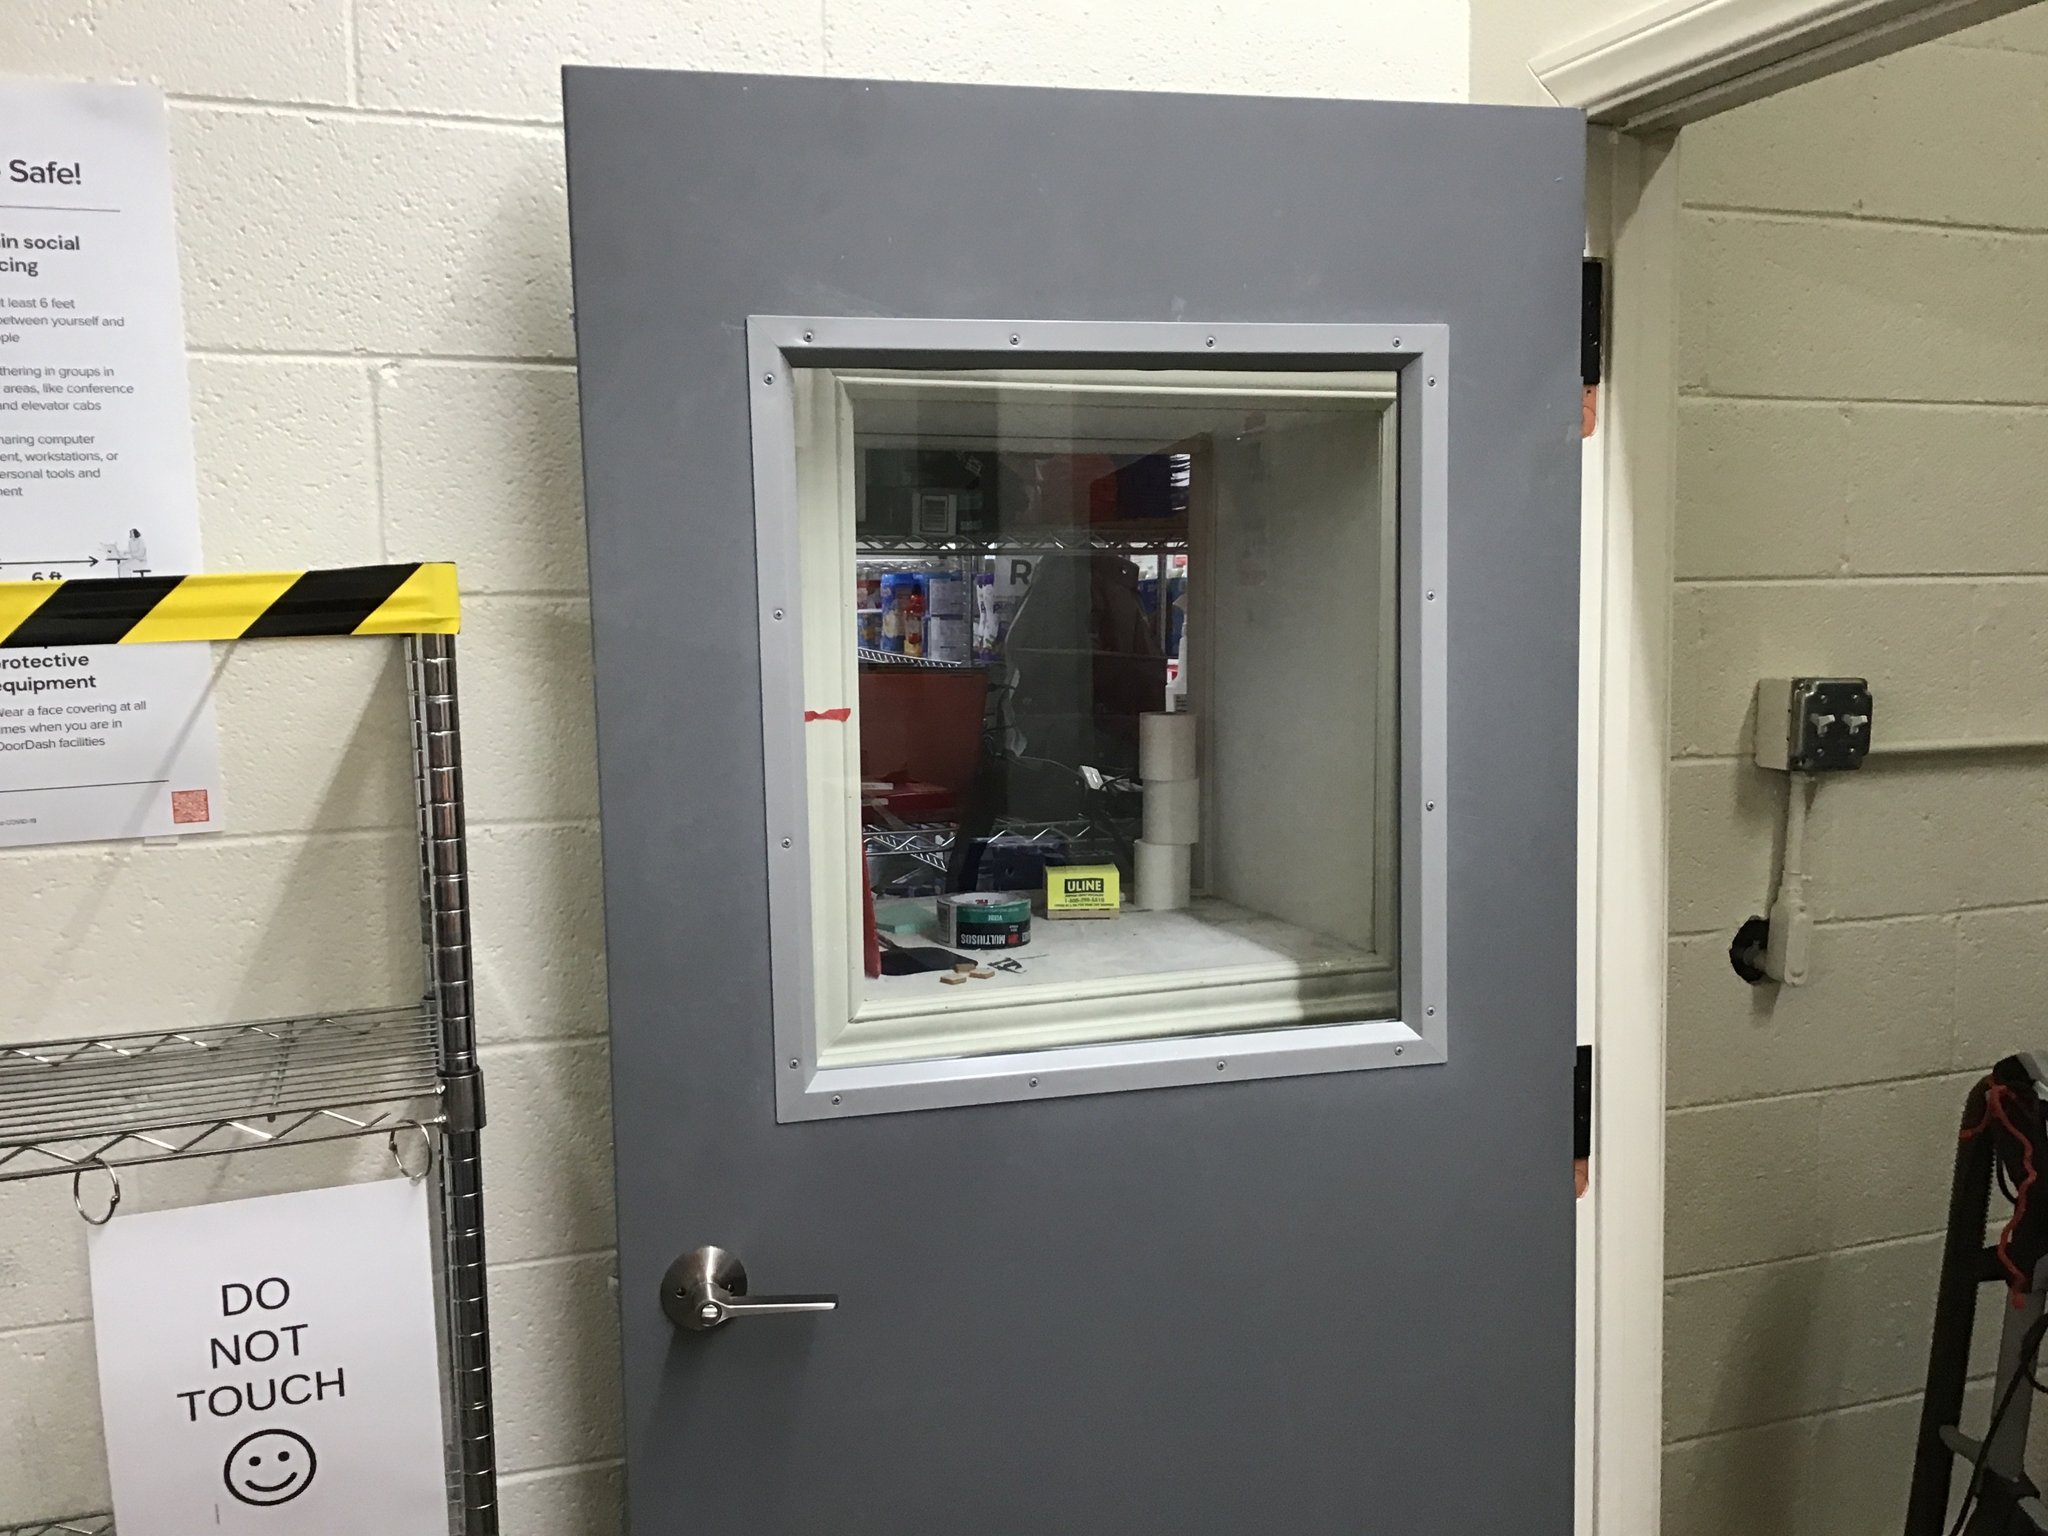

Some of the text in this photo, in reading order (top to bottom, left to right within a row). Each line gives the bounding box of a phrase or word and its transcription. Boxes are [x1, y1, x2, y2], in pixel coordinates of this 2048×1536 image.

[9, 159, 82, 185] Safe!
[0, 233, 80, 251] in social
[8, 297, 37, 309] least
[40, 297, 49, 309] 6
[52, 298, 75, 310] feet
[51, 316, 99, 328] yourself
[102, 317, 125, 328] and
[0, 332, 20, 345] ple
[45, 366, 55, 376] in
[58, 367, 100, 379] groups
[103, 366, 115, 377] in
[3, 383, 134, 395] areas, like conference
[21, 400, 69, 411] elevator
[73, 400, 102, 411] cabs
[38, 435, 95, 447] computer
[25, 451, 103, 462] workstations,
[106, 453, 118, 461] or
[46, 468, 75, 479] tools
[78, 468, 101, 478] and
[0, 653, 90, 670] rotective
[0, 675, 97, 696] quipment
[27, 708, 35, 717] a
[37, 706, 64, 716] face
[66, 702, 117, 716] covering
[120, 702, 131, 712] at
[134, 701, 147, 711] all
[0, 719, 122, 734] mes when you are in
[59, 736, 106, 749] facilities
[1067, 880, 1102, 892] ULINE
[960, 933, 1006, 945] MULTIUSOS
[221, 1277, 291, 1317] DO
[210, 1323, 309, 1369] NOT
[176, 1367, 346, 1422] TOUCH
